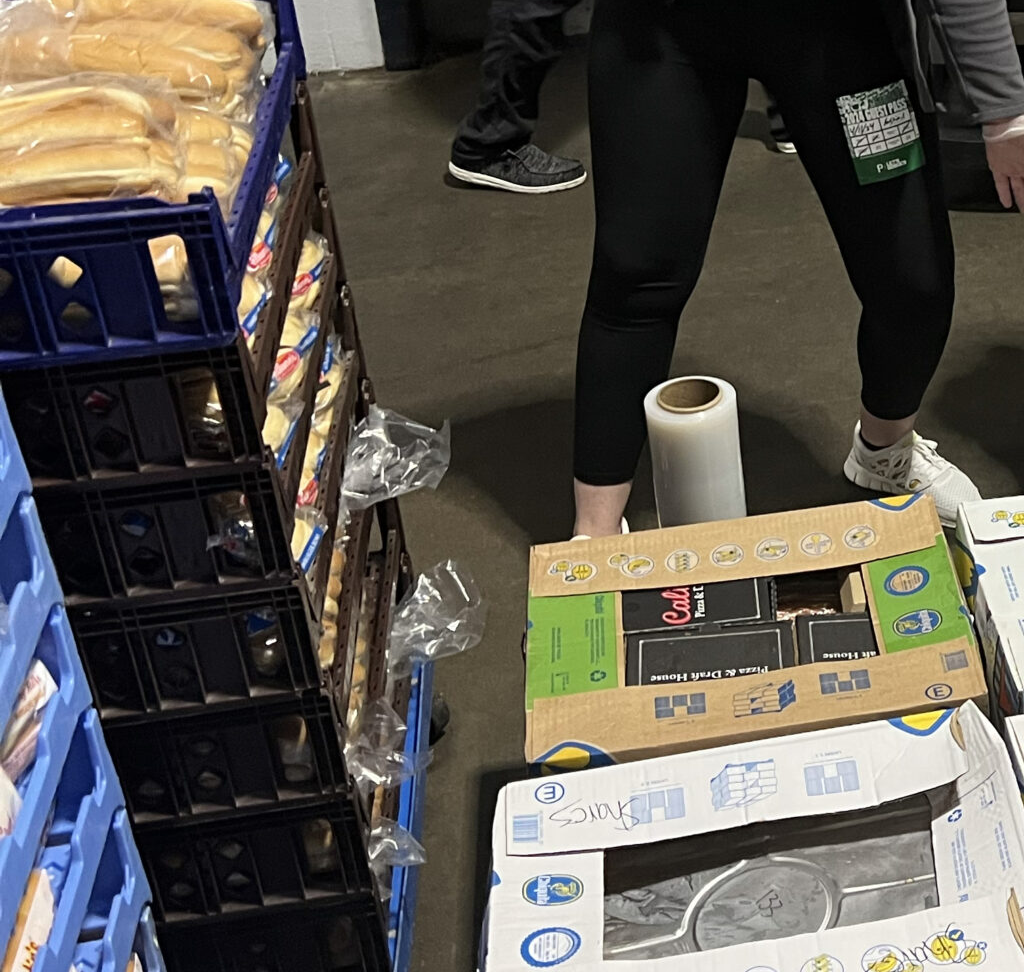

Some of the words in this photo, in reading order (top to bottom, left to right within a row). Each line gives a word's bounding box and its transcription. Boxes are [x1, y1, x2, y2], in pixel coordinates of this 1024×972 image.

[823, 652, 858, 660] House
[738, 665, 769, 675] Pizza
[650, 673, 688, 683] House
[691, 670, 722, 681] Draft
